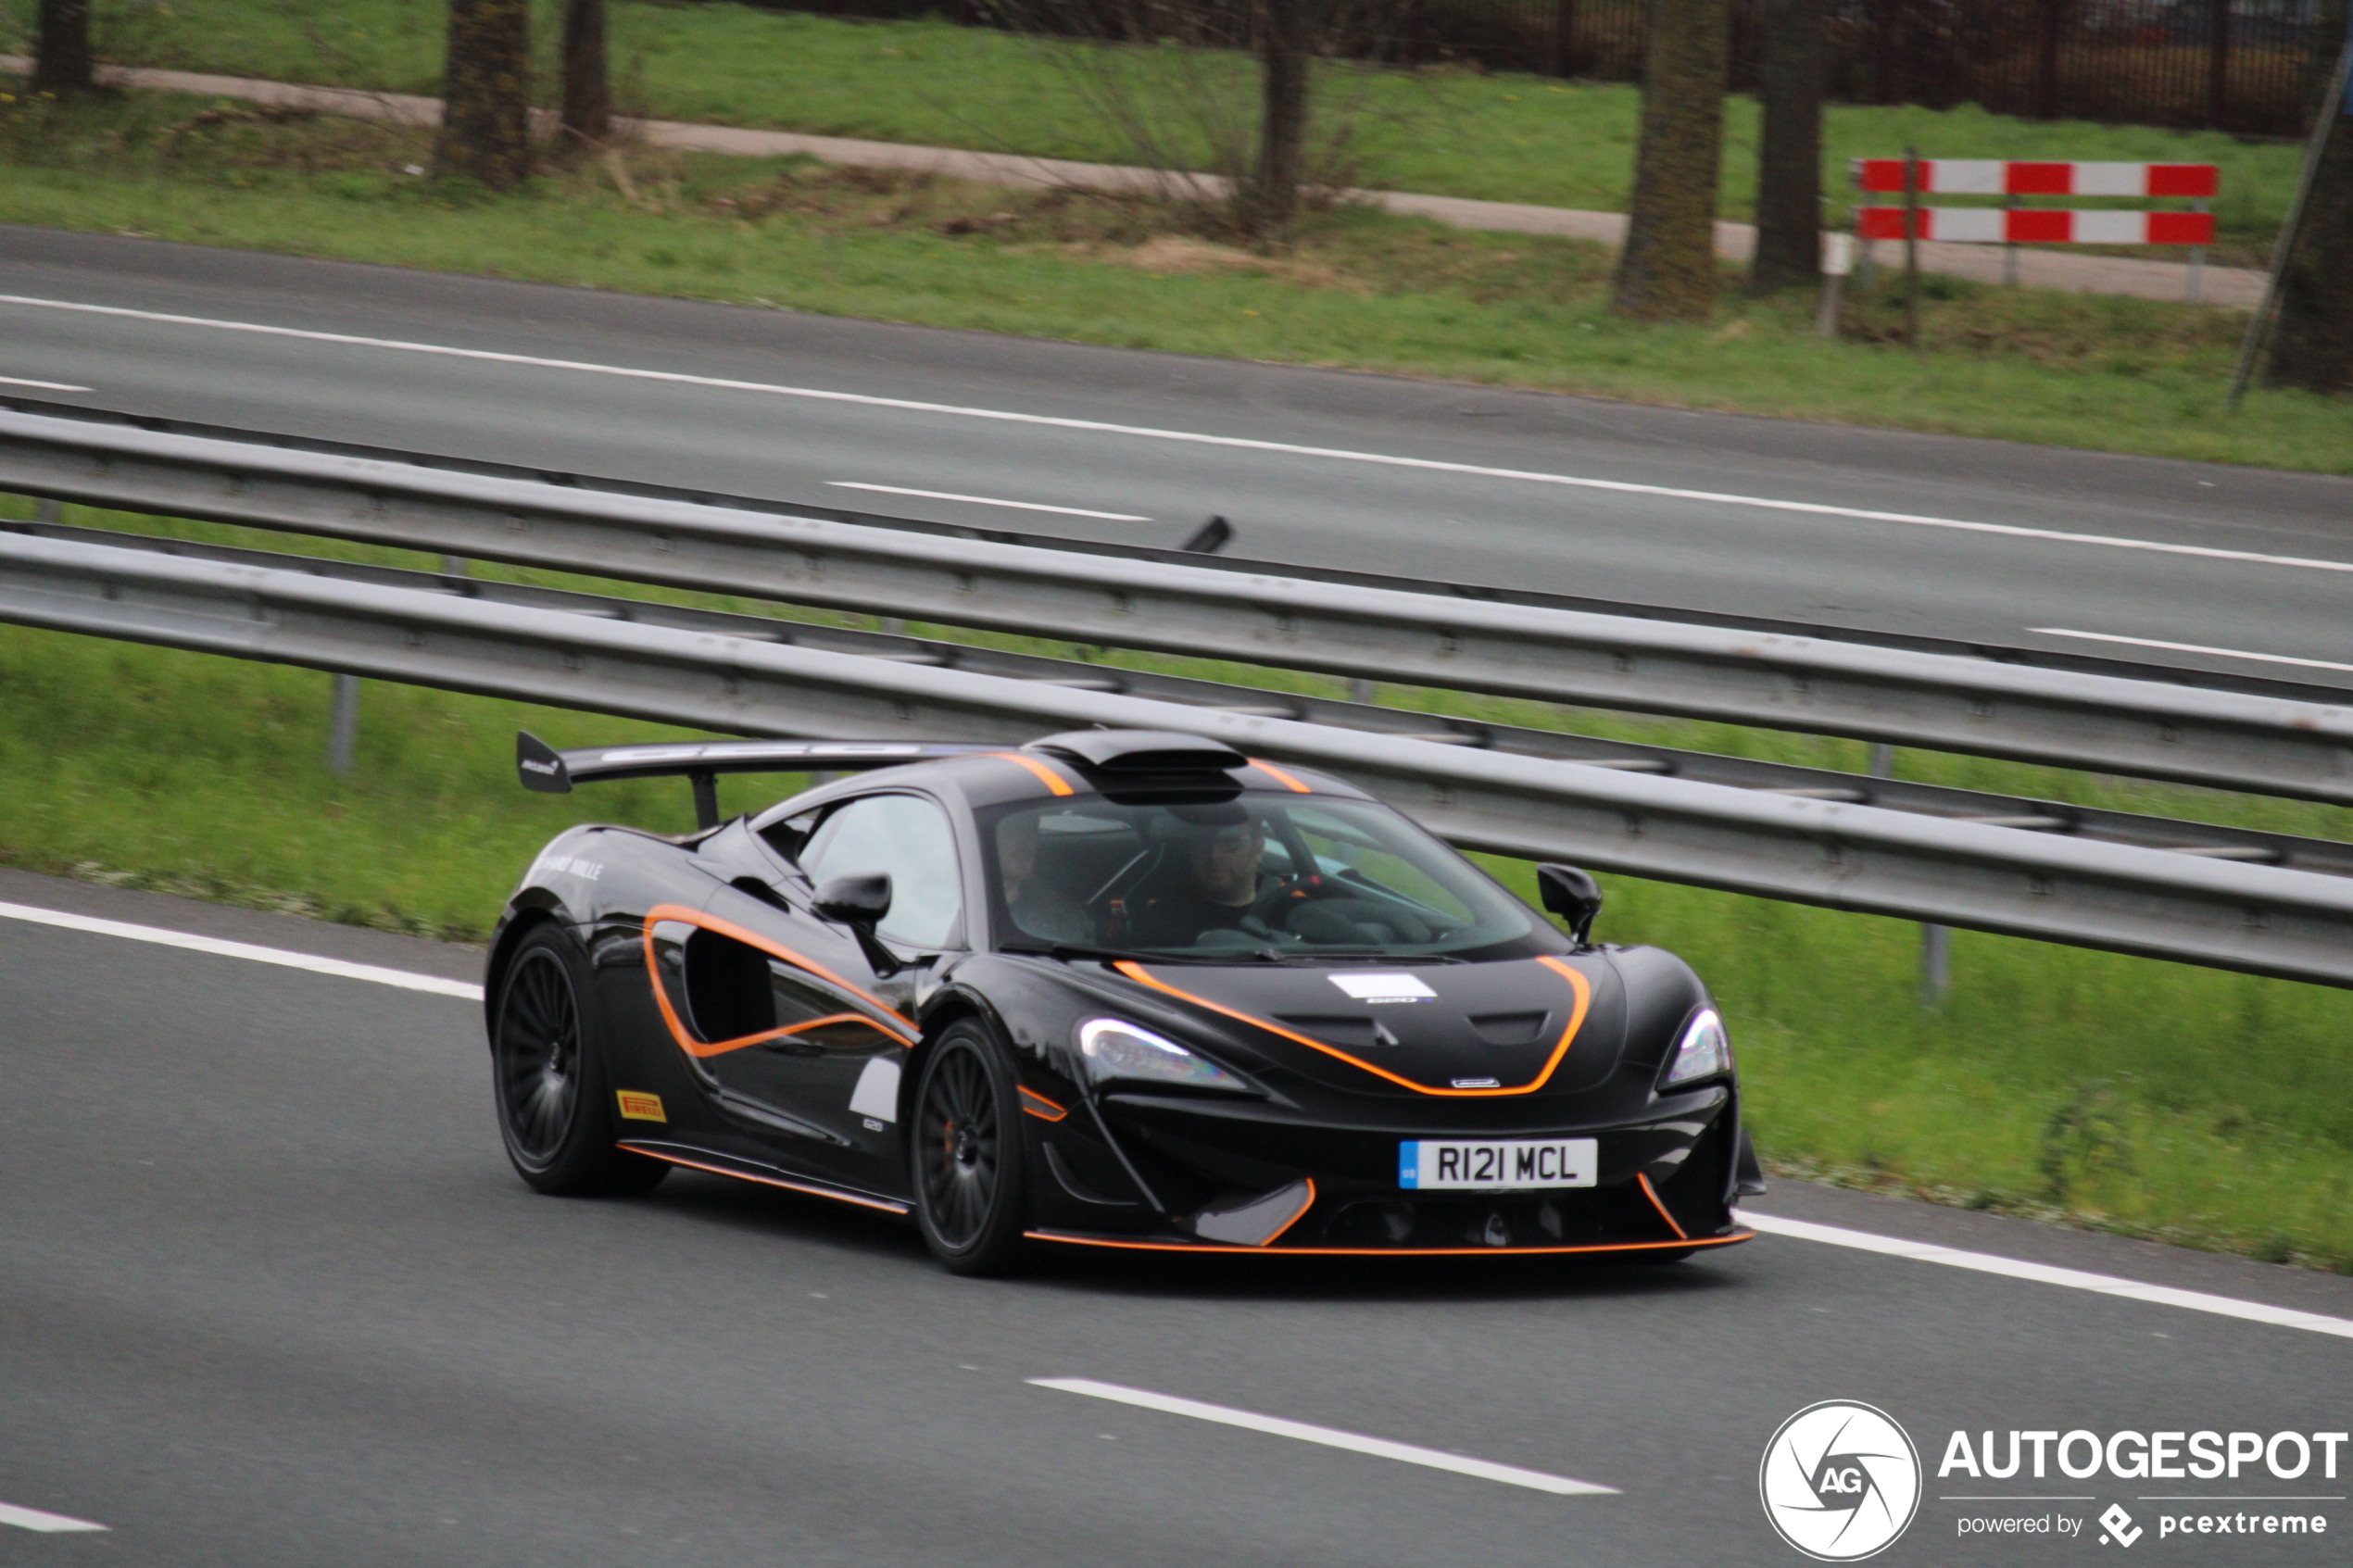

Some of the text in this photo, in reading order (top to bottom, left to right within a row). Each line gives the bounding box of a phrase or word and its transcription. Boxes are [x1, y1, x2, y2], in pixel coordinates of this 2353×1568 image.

[622, 1096, 662, 1118] PIRELLI
[1438, 1146, 1578, 1181] R121 MCL
